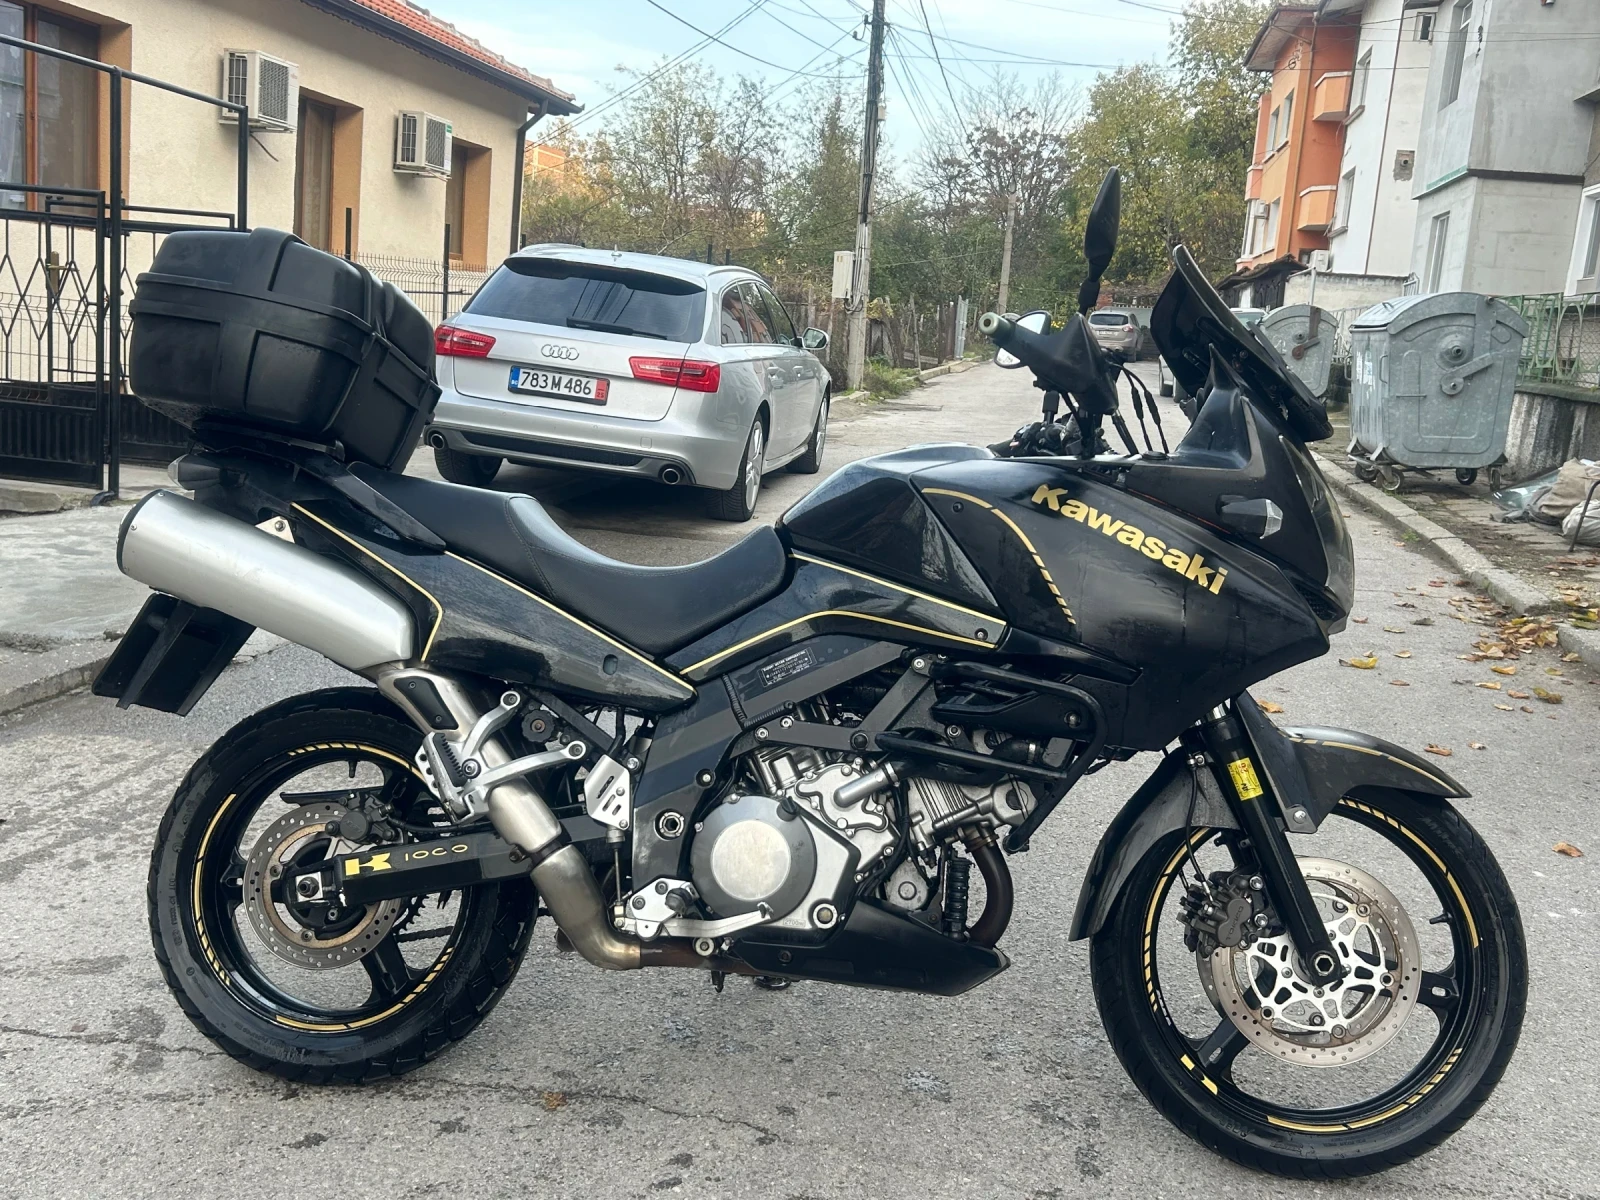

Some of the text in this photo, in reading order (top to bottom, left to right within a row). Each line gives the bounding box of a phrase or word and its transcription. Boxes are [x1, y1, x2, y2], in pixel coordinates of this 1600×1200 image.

[520, 371, 592, 395] 783 M 486
[1031, 484, 1228, 595] Kawasaki
